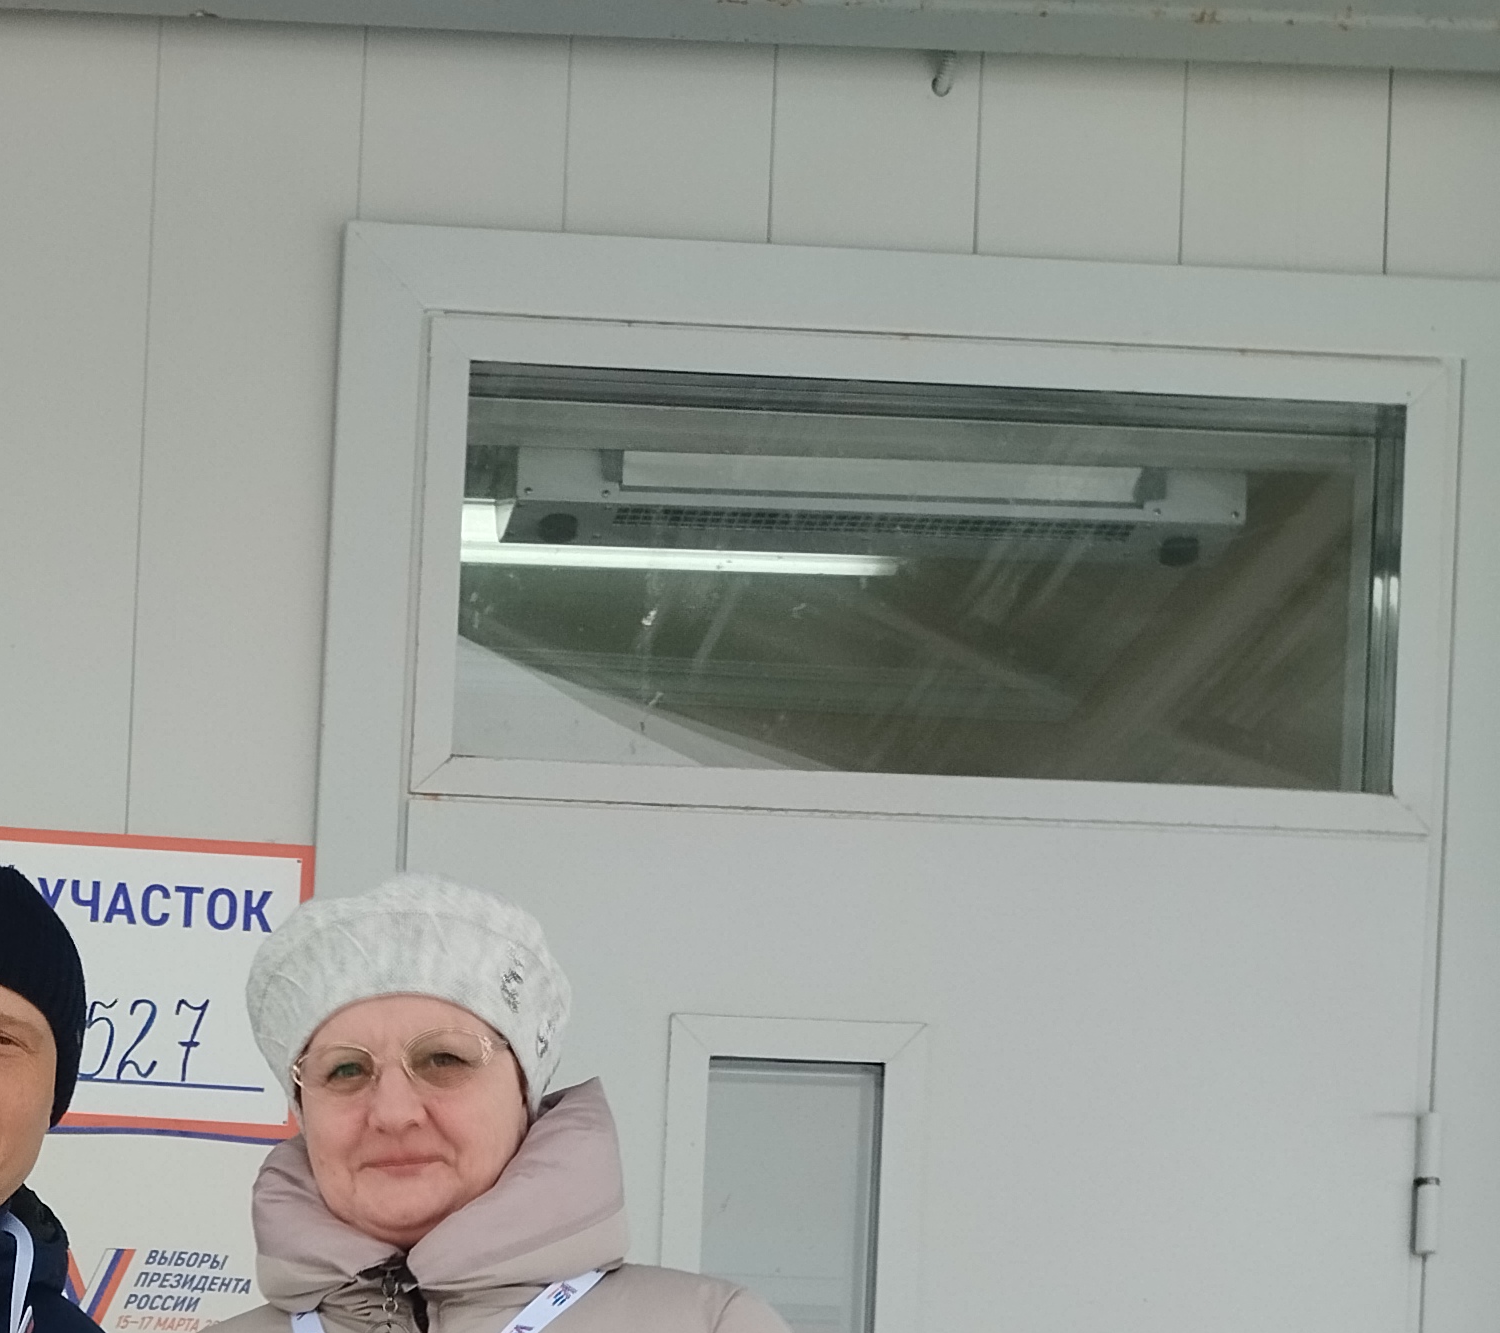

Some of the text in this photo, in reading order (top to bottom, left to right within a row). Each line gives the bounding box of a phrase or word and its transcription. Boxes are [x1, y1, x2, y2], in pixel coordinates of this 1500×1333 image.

[37, 877, 273, 933] УЧАСТОК
[78, 997, 210, 1083] 527
[144, 1249, 229, 1271] ВЫБОРЫ
[133, 1271, 252, 1295] ПРЕЗИДЕНТА
[123, 1293, 202, 1313] РОССИИ
[153, 1316, 200, 1333] МАРТА
